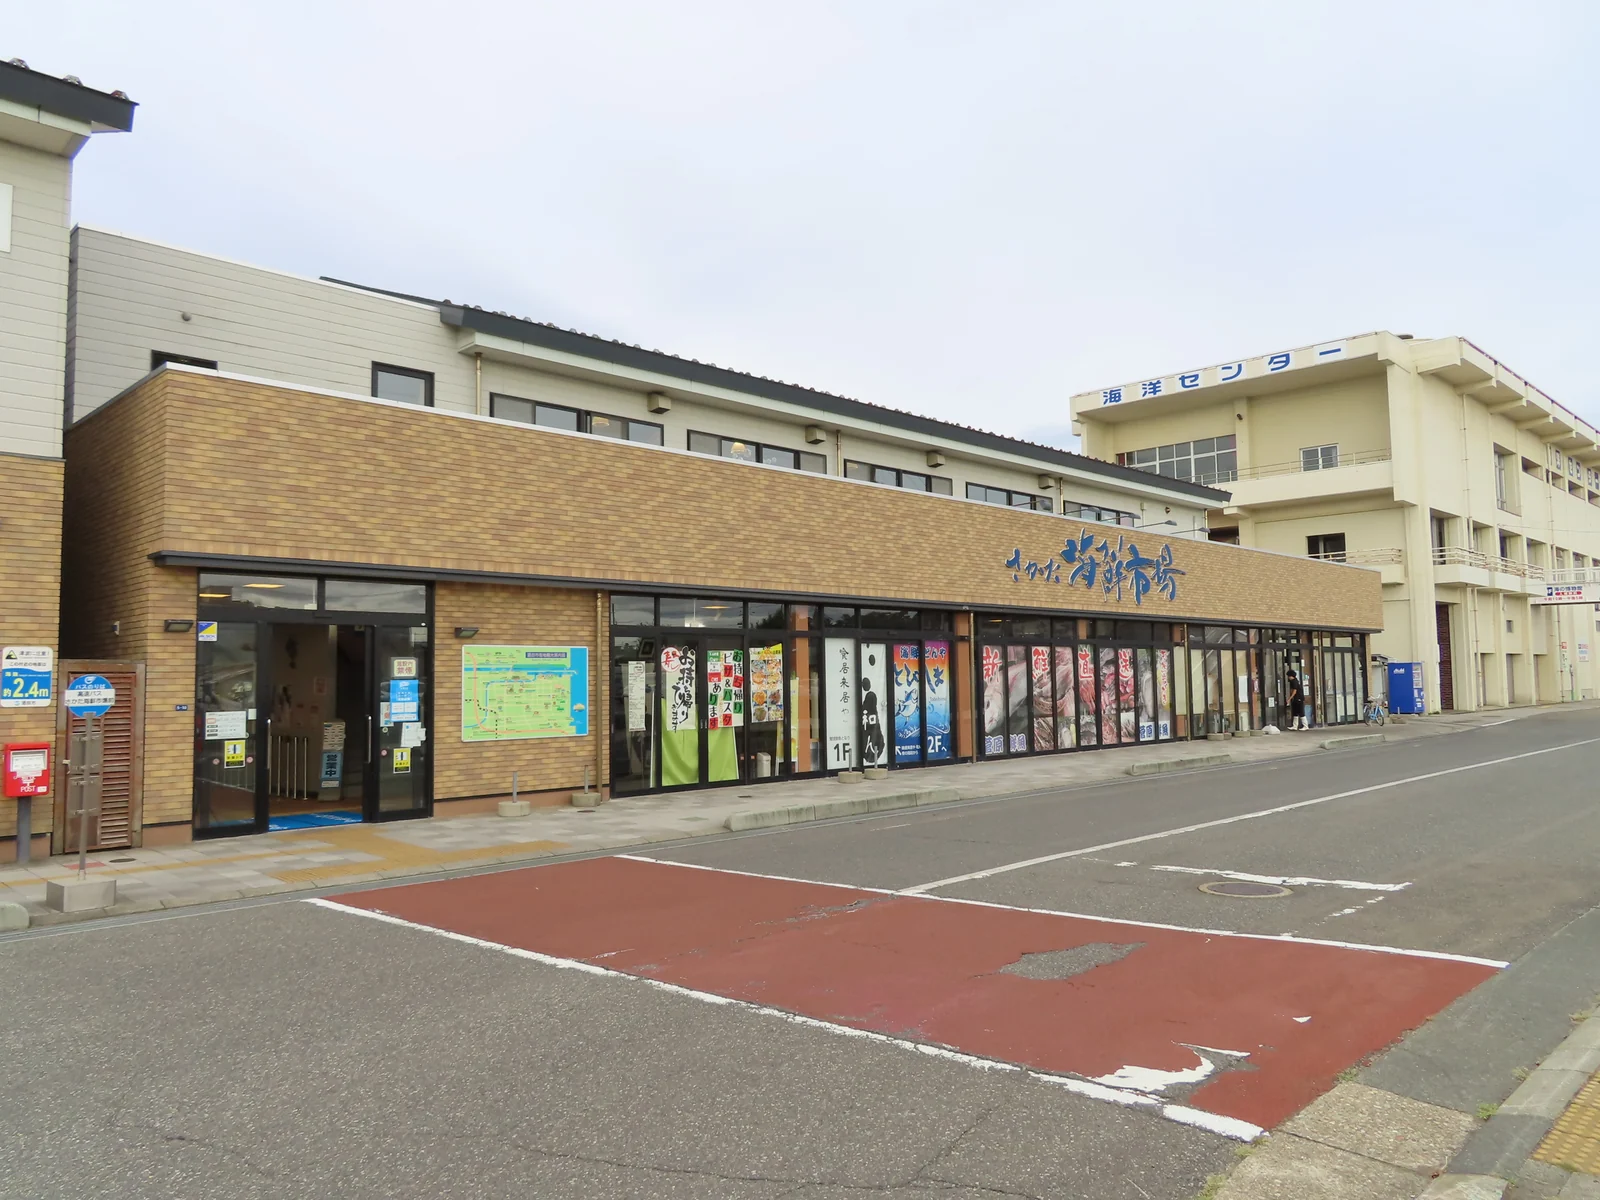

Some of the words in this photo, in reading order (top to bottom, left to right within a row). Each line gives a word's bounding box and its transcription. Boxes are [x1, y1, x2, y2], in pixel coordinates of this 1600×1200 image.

[1103, 347, 1342, 406] 海洋センター
[1005, 527, 1187, 606] さかた海鮮市場
[3, 677, 49, 698] 約2.4m
[397, 667, 414, 675] 禁煙
[723, 652, 734, 726] ピザ&パスタ
[733, 649, 744, 714] お持ち帰り
[709, 682, 722, 730] あります
[833, 742, 850, 762] 1F
[862, 709, 879, 754] 和ん
[325, 753, 339, 778] 営業中
[20, 785, 36, 793] POST
